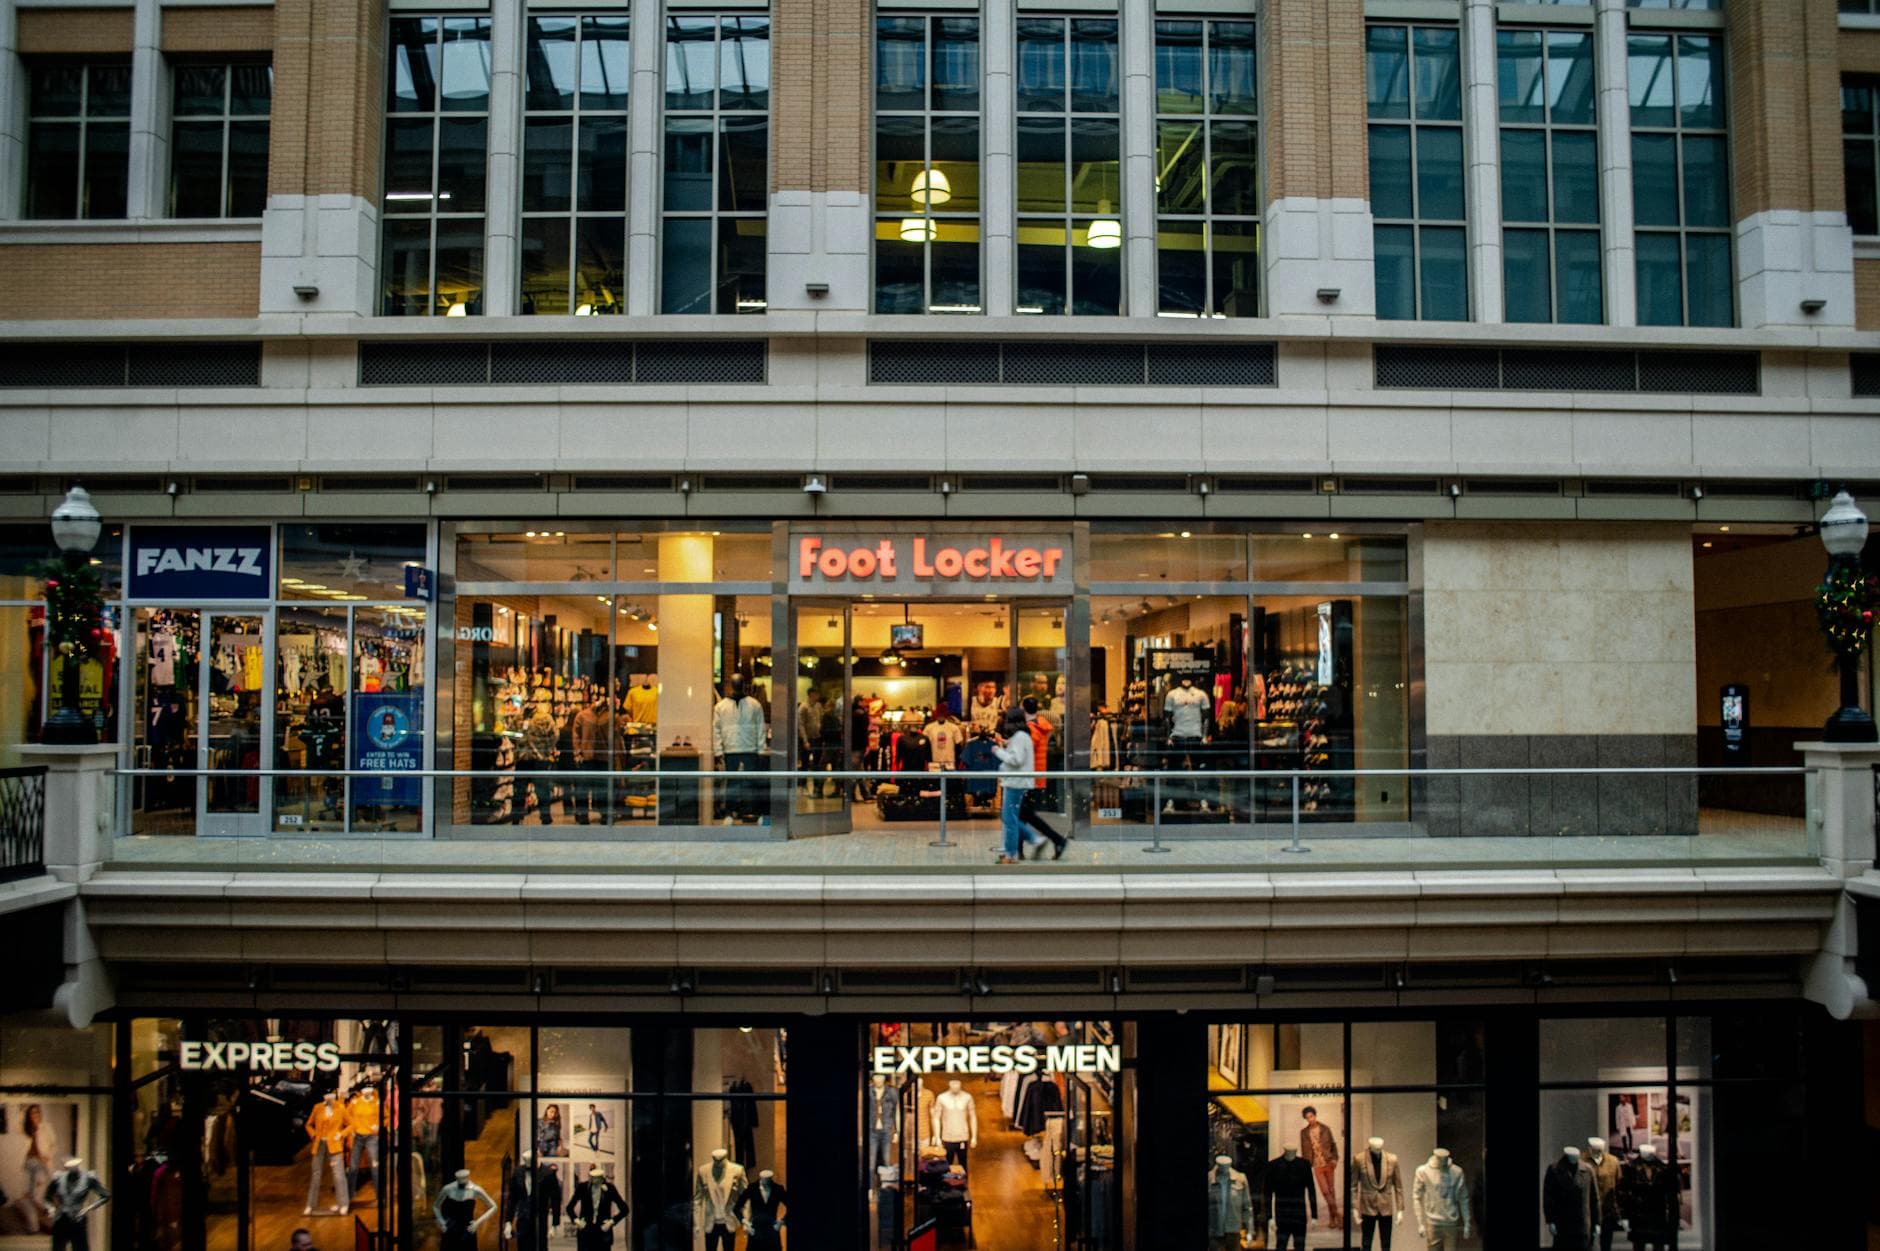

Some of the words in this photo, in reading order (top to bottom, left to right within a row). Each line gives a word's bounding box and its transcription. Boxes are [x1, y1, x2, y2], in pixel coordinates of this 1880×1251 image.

[137, 548, 262, 576] FANZZ
[800, 537, 896, 577] Foot
[913, 537, 1062, 578] Locker
[360, 758, 386, 769] FREE
[389, 758, 416, 769] HATS
[180, 1041, 340, 1072] EXPRESS
[874, 1045, 1038, 1075] EXPRESS
[1046, 1045, 1121, 1074] MEN
